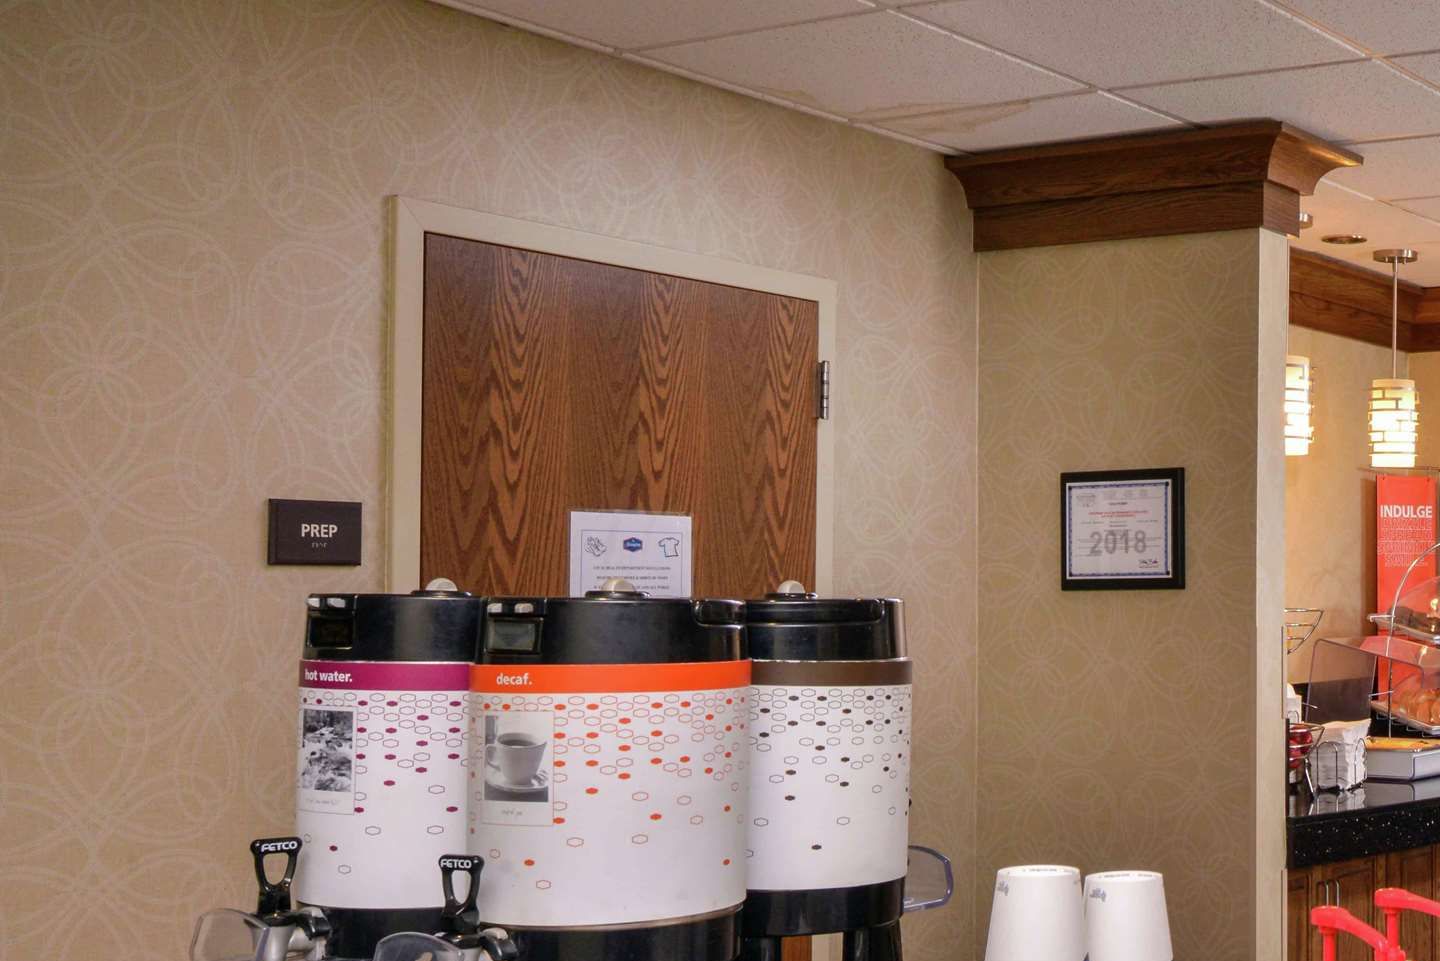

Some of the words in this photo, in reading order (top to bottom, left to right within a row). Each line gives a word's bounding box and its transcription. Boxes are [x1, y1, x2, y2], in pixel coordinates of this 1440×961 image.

[1380, 504, 1433, 518] INDULGE
[301, 523, 338, 538] PREP
[1089, 529, 1147, 556] 2018
[304, 668, 318, 682] hot
[496, 672, 532, 686] decaf.
[261, 840, 298, 852] FETCO
[440, 859, 472, 868] FETCO
